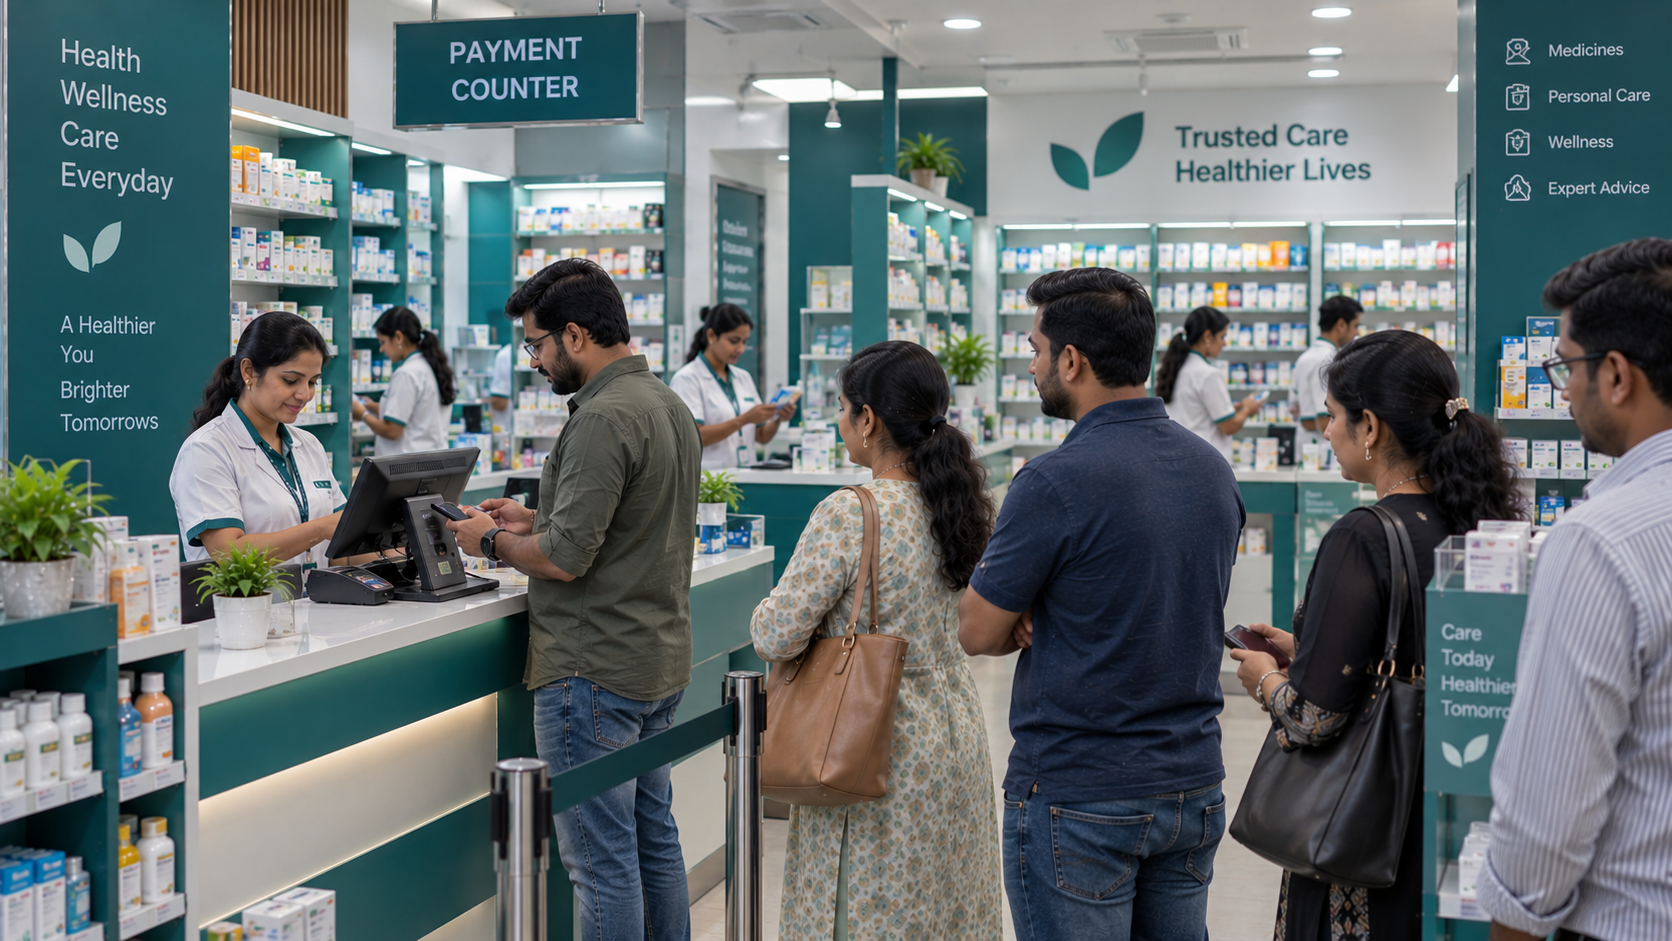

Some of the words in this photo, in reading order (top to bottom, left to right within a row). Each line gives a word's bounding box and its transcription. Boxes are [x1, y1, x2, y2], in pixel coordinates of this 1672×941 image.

[62, 39, 140, 73] Health
[451, 37, 582, 64] PAYMENT
[1549, 43, 1623, 57] Medicines
[61, 80, 166, 115] Wellness
[452, 76, 578, 101] COUNTER
[1549, 89, 1611, 103] Personal
[1616, 89, 1650, 101] Care
[61, 121, 118, 150] Care
[1176, 124, 1277, 148] Trusted
[1287, 124, 1348, 146] Care
[1549, 135, 1613, 148] Wellness
[62, 162, 173, 200] Everyday
[1177, 159, 1294, 182] Healthier
[1305, 158, 1371, 180] Lives
[1549, 182, 1596, 198] Expert
[1600, 181, 1649, 194] Advice
[61, 316, 73, 333] A
[80, 316, 155, 334] Healthier
[61, 345, 93, 363] You
[62, 380, 130, 403] Brighter
[60, 414, 158, 431] Tomorrows
[1442, 623, 1482, 641] Care
[1441, 649, 1494, 671] Today
[1441, 699, 1511, 719] Tomorro
